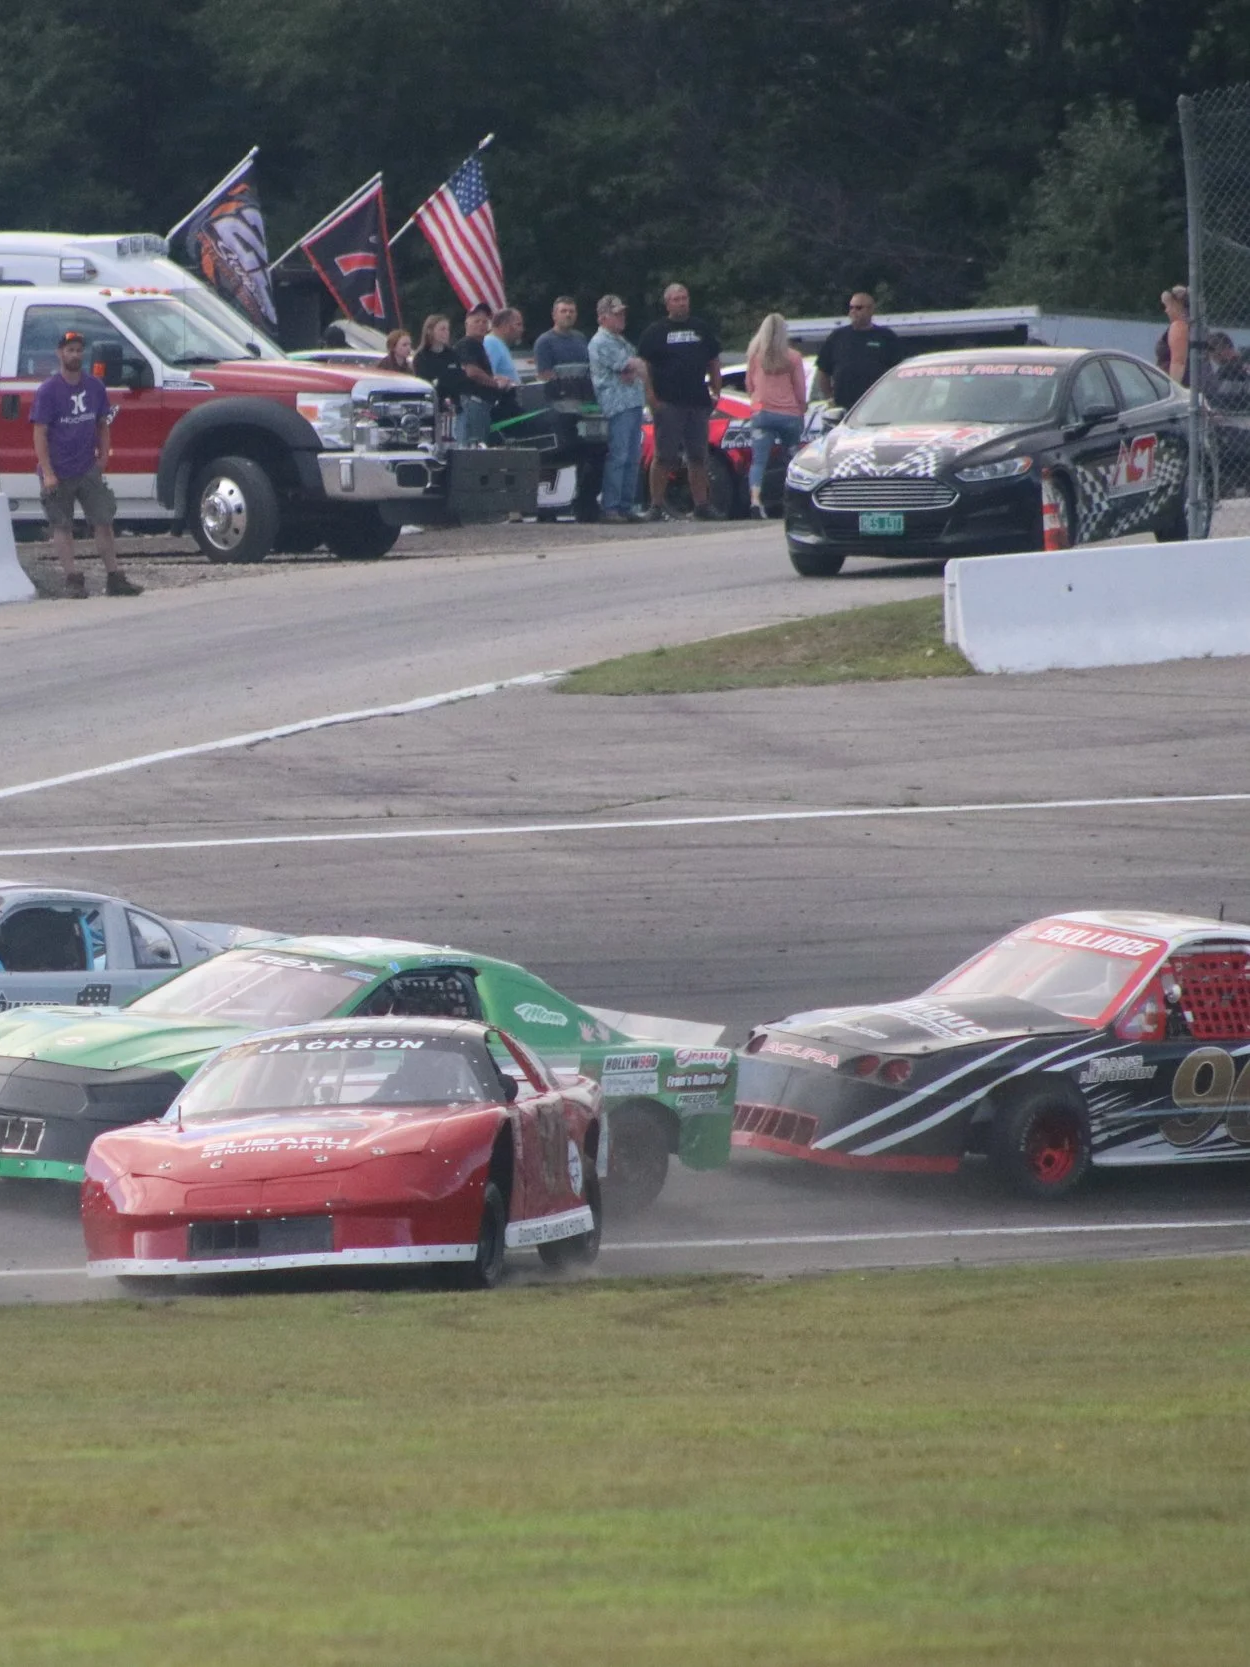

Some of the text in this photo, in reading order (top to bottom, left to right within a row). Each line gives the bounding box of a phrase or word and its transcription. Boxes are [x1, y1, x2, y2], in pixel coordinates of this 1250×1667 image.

[1018, 365, 1057, 376] CAR
[1037, 925, 1161, 957] SKILLINGS
[250, 954, 336, 973] RSX
[258, 1039, 426, 1055] JACKSON
[759, 1040, 840, 1069] ACURA
[200, 1143, 350, 1158] GENUINE PARTS
[202, 1136, 351, 1152] SUBARU
